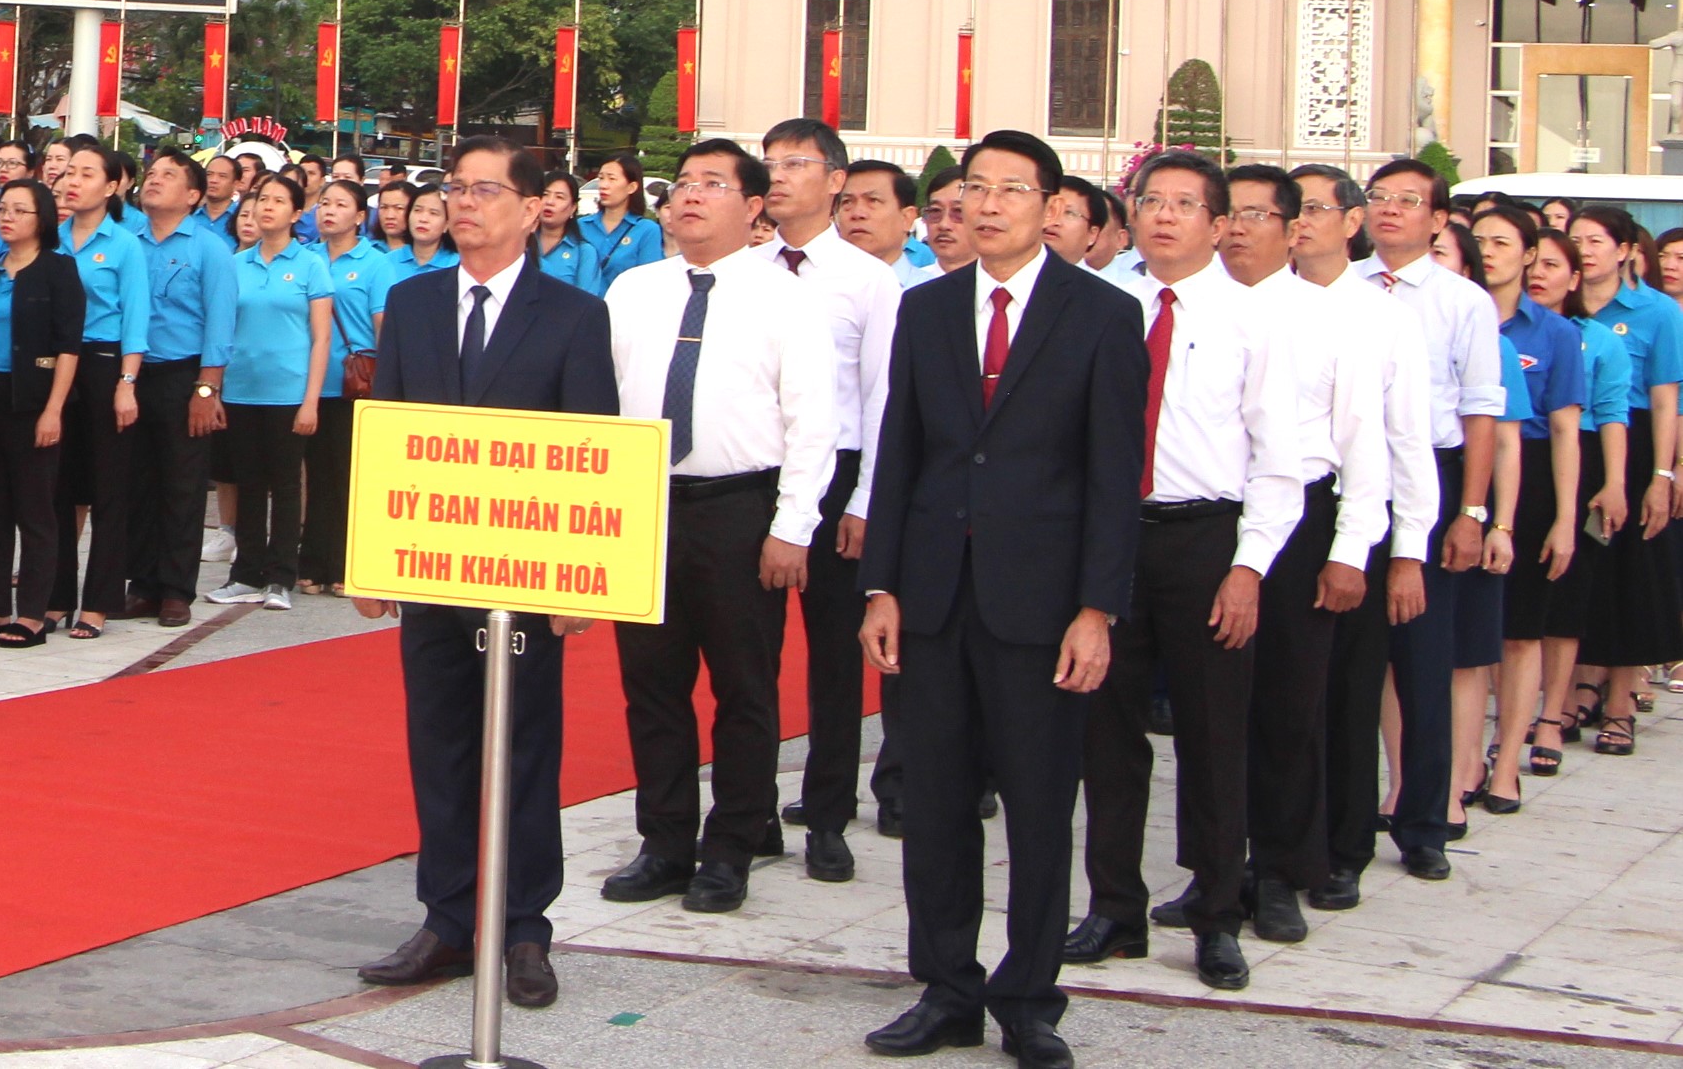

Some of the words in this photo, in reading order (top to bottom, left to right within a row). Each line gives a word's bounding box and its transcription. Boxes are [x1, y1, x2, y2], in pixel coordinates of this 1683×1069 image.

[220, 117, 249, 140] 100
[250, 115, 288, 143] NĂM
[406, 433, 480, 465] ĐOÀN
[489, 440, 536, 474] ĐẠI
[546, 437, 609, 475] BIỂU
[387, 484, 420, 520] UỶ
[428, 493, 480, 526] BAN
[488, 496, 559, 533] NHÂN
[568, 501, 623, 538] DÂN
[395, 543, 452, 582] TỈNH
[460, 554, 547, 590] KHÁNH
[555, 562, 609, 596] HOÀ
